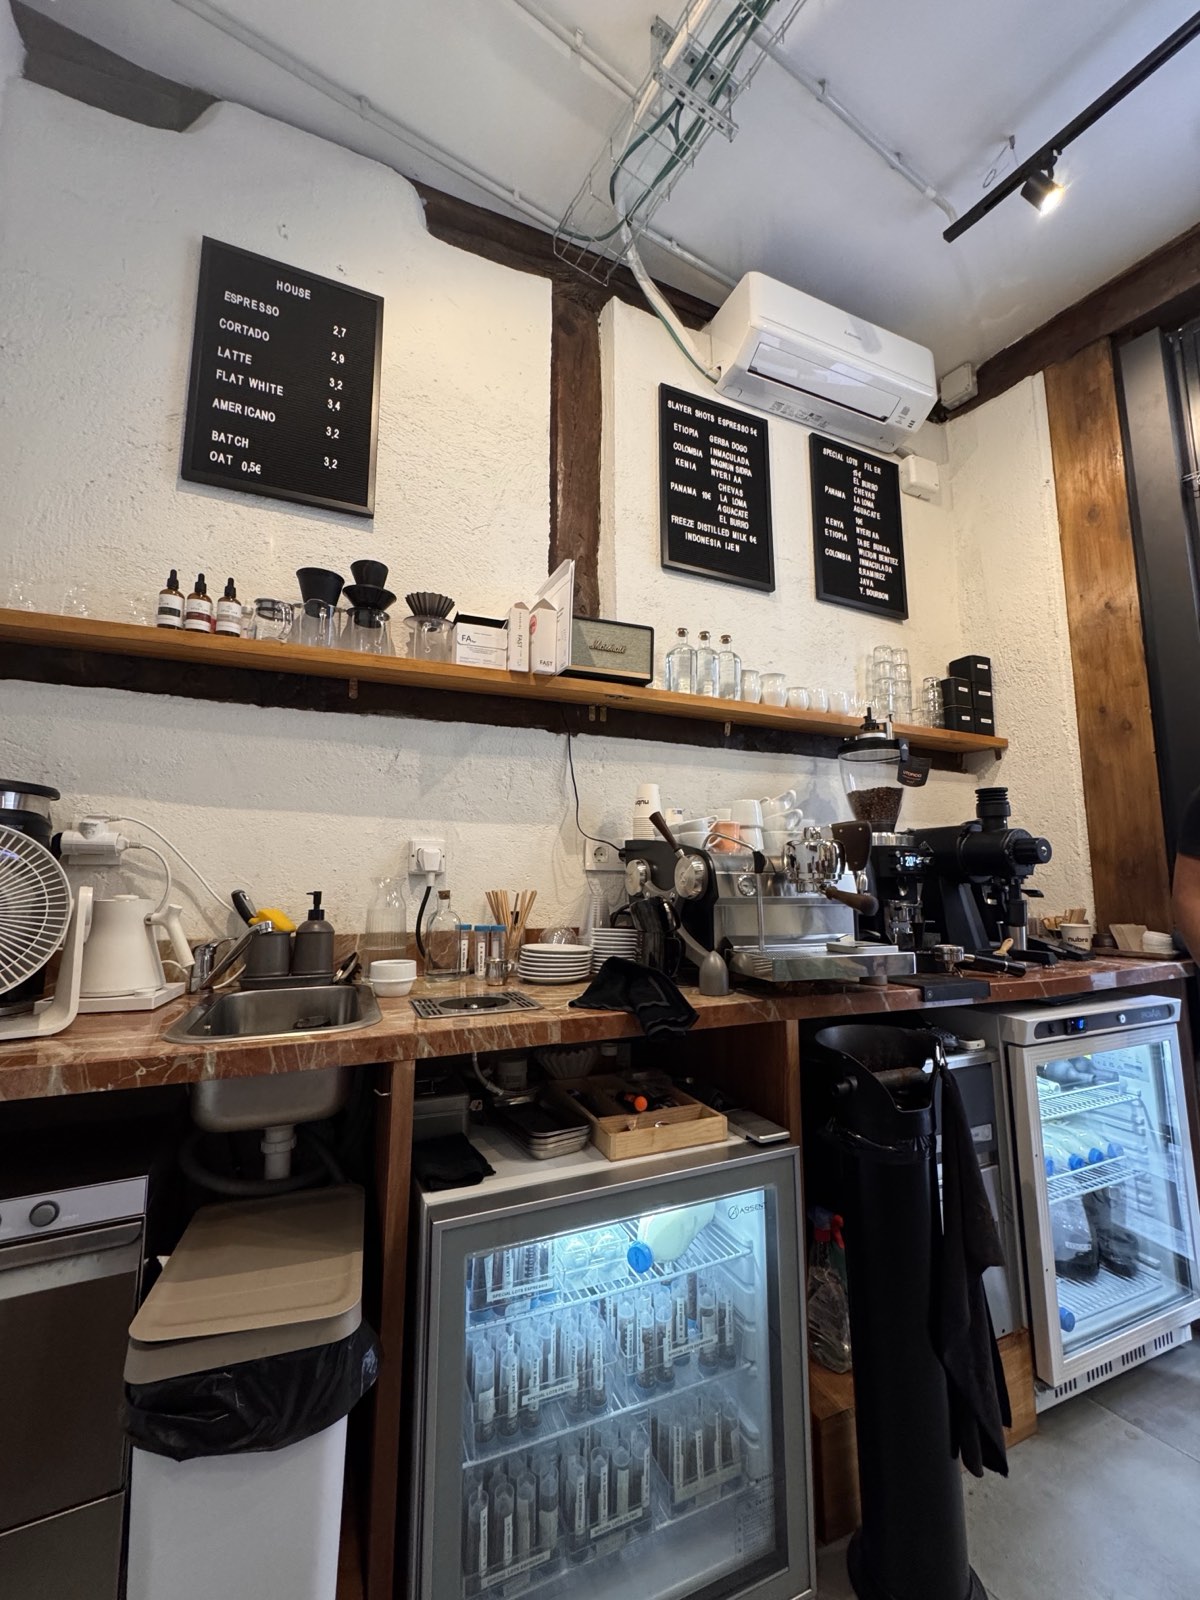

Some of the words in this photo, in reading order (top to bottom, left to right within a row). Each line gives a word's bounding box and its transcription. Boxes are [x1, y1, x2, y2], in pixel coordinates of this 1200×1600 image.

[276, 280, 311, 300] HOUSE
[224, 290, 280, 317] ESPRESSO
[219, 318, 270, 341] CORTADO
[217, 346, 252, 365] LATTE
[216, 369, 244, 386] FLAT
[248, 378, 284, 396] WHITE
[212, 398, 276, 423] AMERICANO
[667, 400, 692, 415] SLAYER
[694, 410, 714, 422] SHOTS
[718, 417, 749, 434] ESPRESSO
[212, 430, 249, 448] BATCH
[673, 422, 699, 438] ETIOPIA
[709, 435, 729, 448] GERBA
[732, 442, 748, 454] DOGO
[209, 451, 233, 466] OAT
[241, 461, 261, 475] 0,5€
[673, 442, 703, 458] COLOMBIA
[710, 447, 750, 466] INMACULADA
[822, 448, 844, 462] SPECIAL
[846, 456, 858, 466] LOTS
[675, 457, 696, 471] KENIA
[710, 468, 731, 482] NYERI
[733, 475, 742, 484] AA
[735, 465, 752, 477] SIDRA
[853, 477, 860, 485] EL
[670, 482, 697, 497] PANAMA
[701, 491, 712, 500] 10€
[719, 494, 727, 503] LA
[732, 497, 747, 508] LOMA
[718, 483, 743, 497] CHEVAS
[824, 485, 846, 500] PANAMA
[854, 496, 860, 504] LA
[862, 498, 874, 509] LOMA
[854, 486, 875, 500] CHEVAS
[719, 515, 727, 524] EL
[730, 518, 749, 530] BURRO
[853, 505, 881, 520] AGUACATE
[671, 515, 695, 528] FREEZE
[697, 522, 729, 537] DISTILLED
[732, 531, 747, 542] MILK
[824, 528, 848, 542] ETIOPIA
[825, 516, 844, 529] KENYA
[872, 531, 880, 540] AA
[685, 531, 721, 548] INDONESIA
[725, 542, 740, 552] IJEN
[825, 548, 852, 562] COLOMBIA
[860, 577, 874, 588] JAVA
